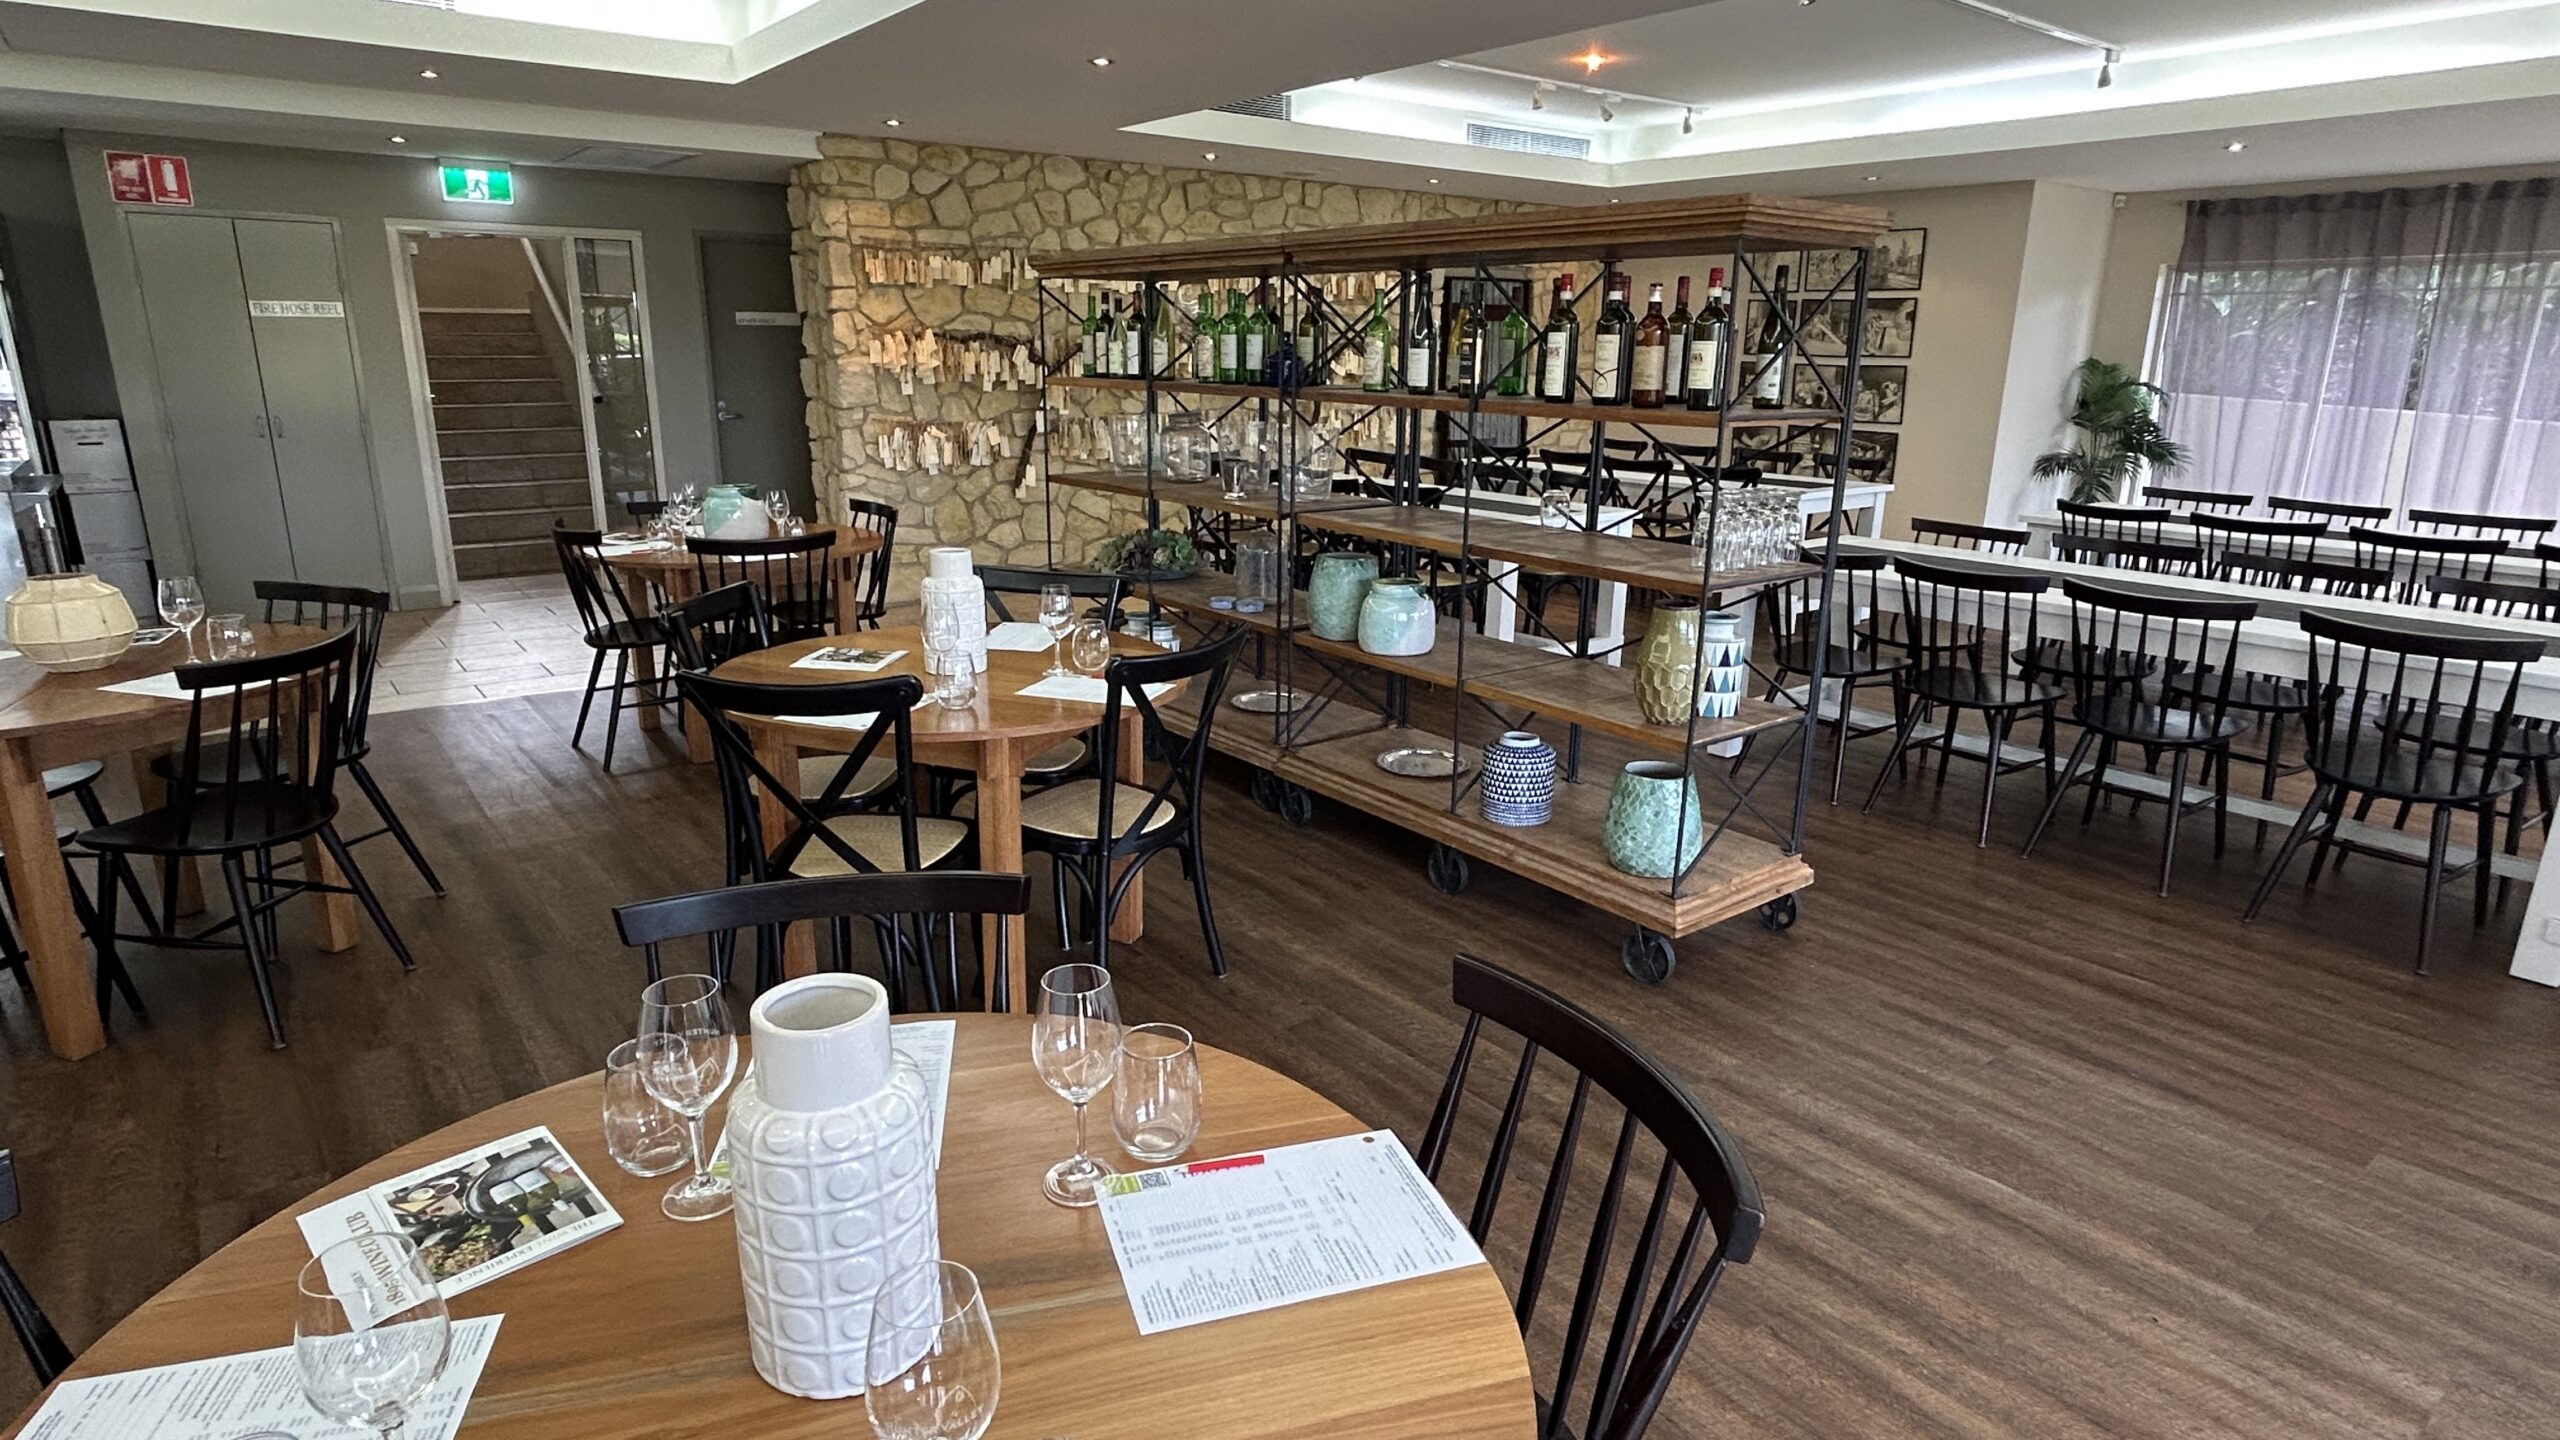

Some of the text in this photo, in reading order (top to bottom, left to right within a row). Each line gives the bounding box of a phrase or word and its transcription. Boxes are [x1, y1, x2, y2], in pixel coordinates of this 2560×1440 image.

[252, 302, 343, 315] FIRE HOSE REEL
[455, 1245, 533, 1284] EXPERIENCE
